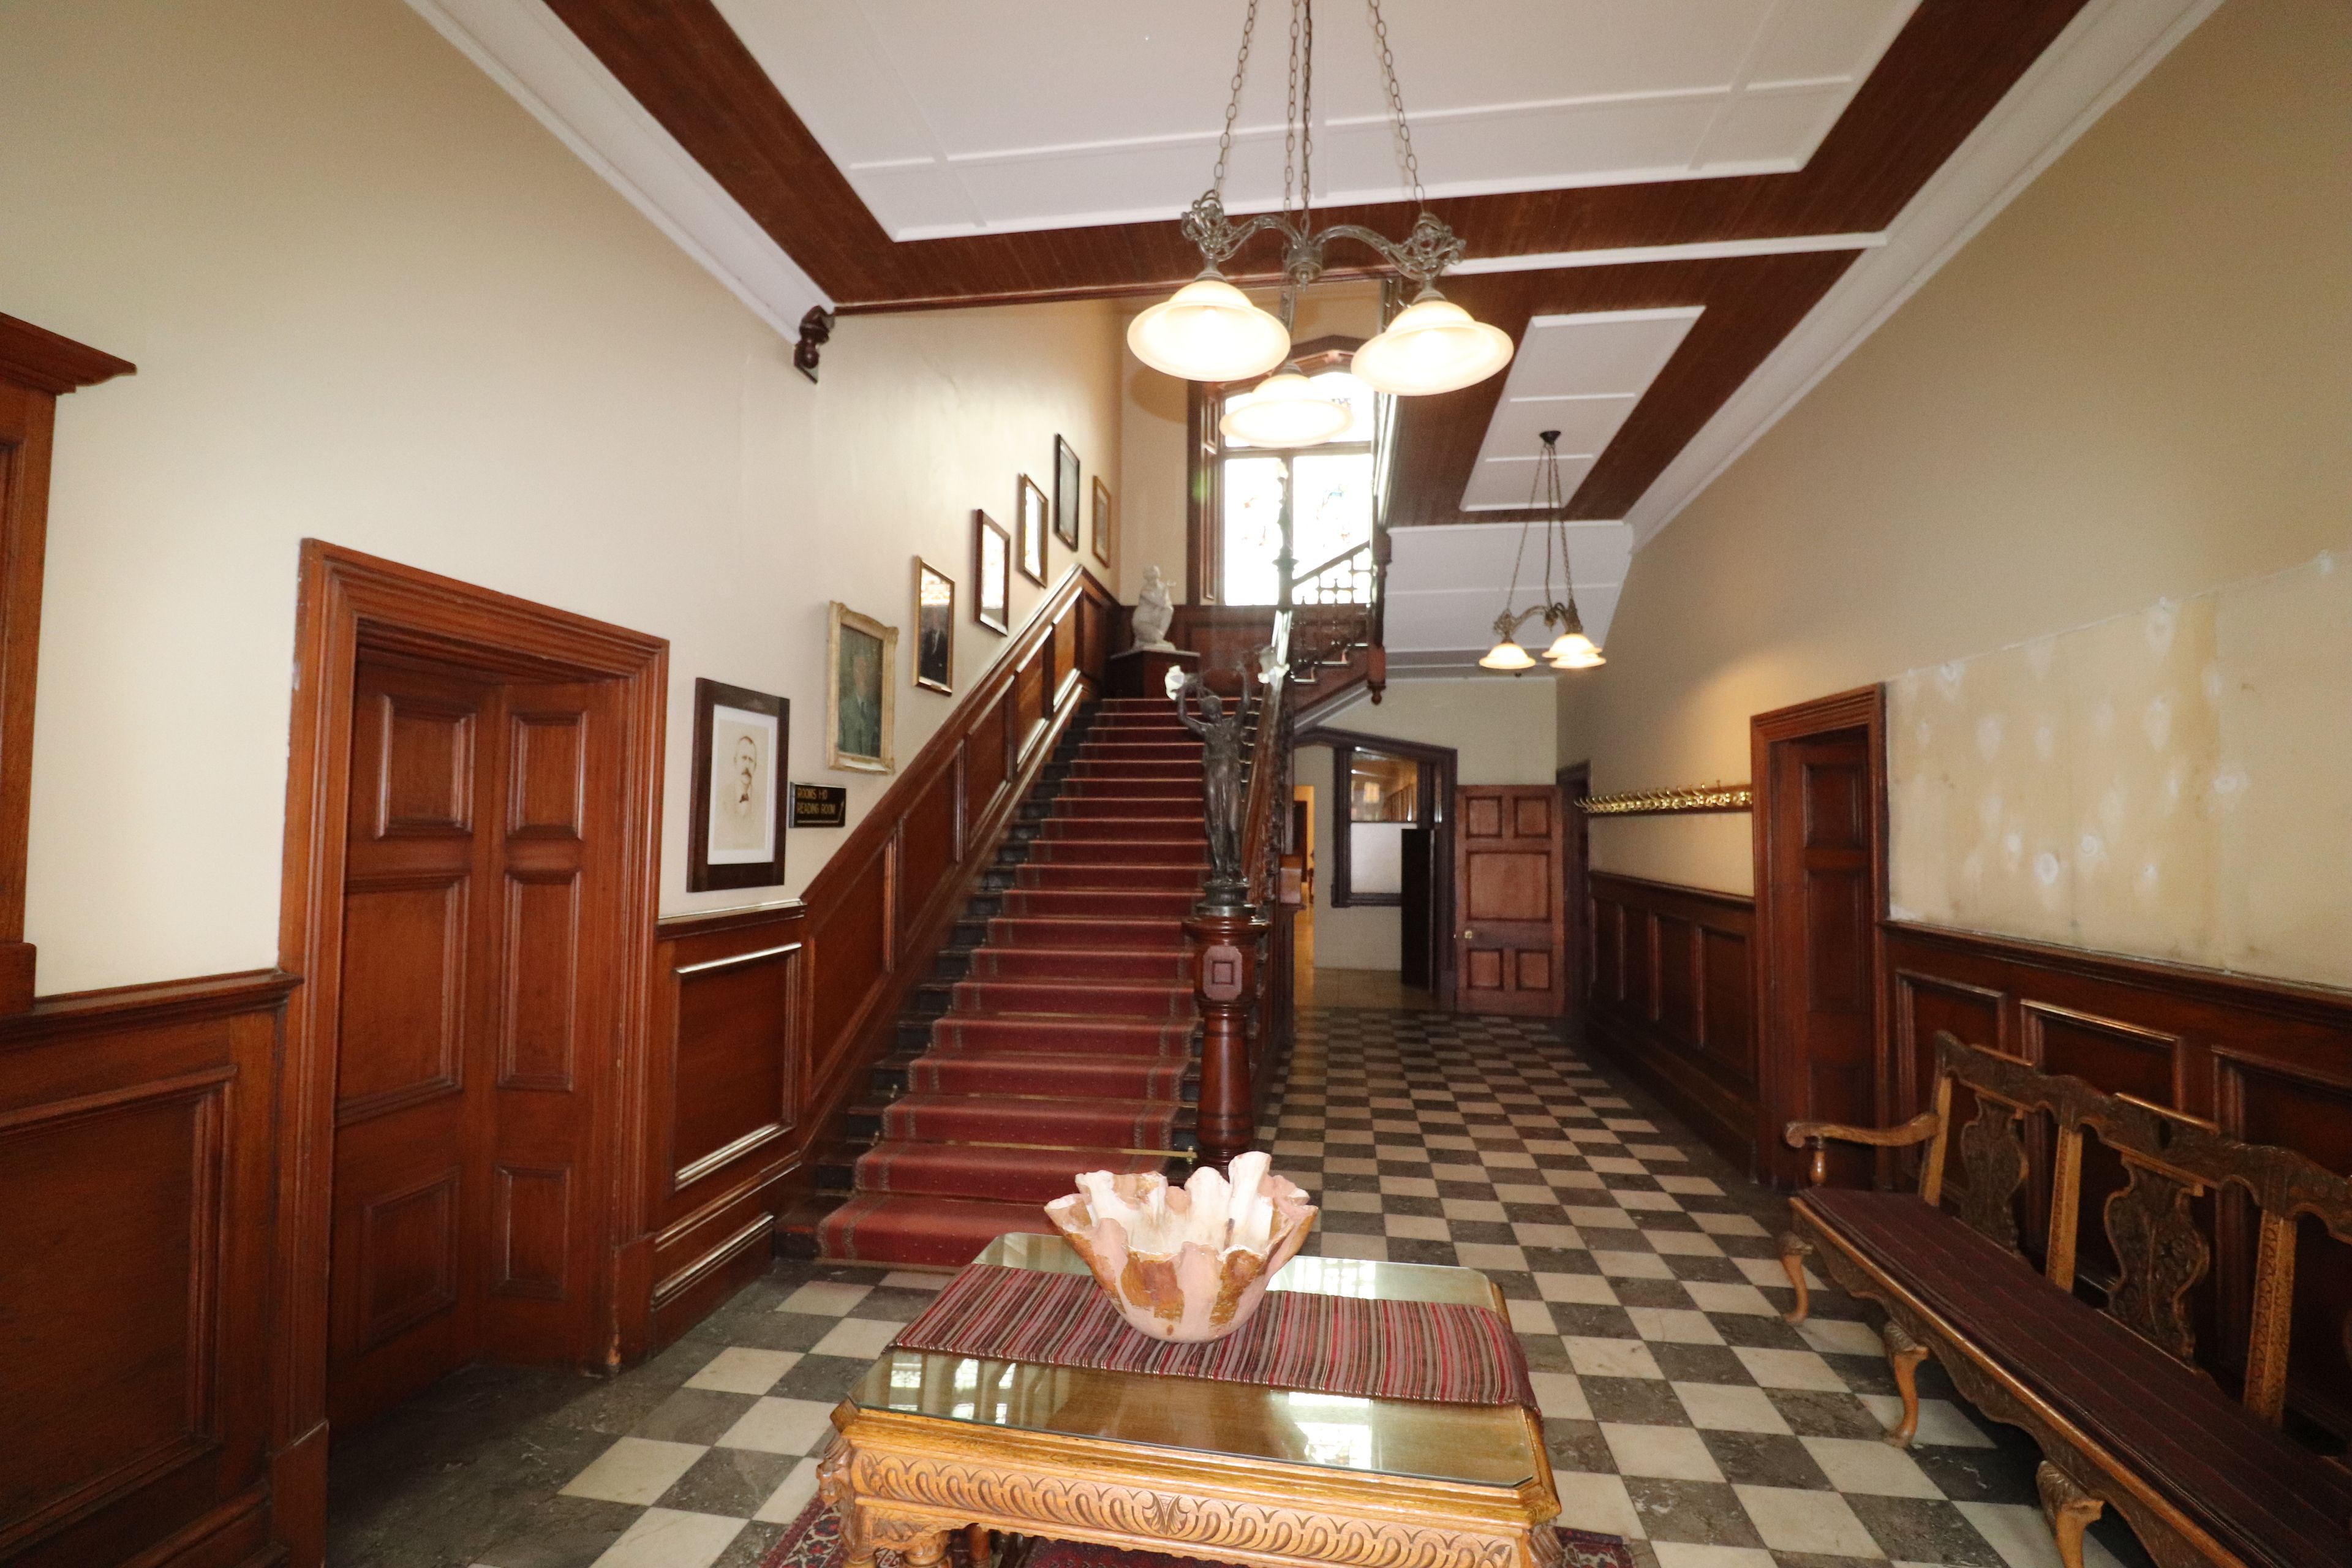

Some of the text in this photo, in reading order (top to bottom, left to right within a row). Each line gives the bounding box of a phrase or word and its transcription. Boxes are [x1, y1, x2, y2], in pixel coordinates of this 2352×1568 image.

[797, 788, 816, 799] ROOMS
[797, 802, 836, 815] READING ROOM
